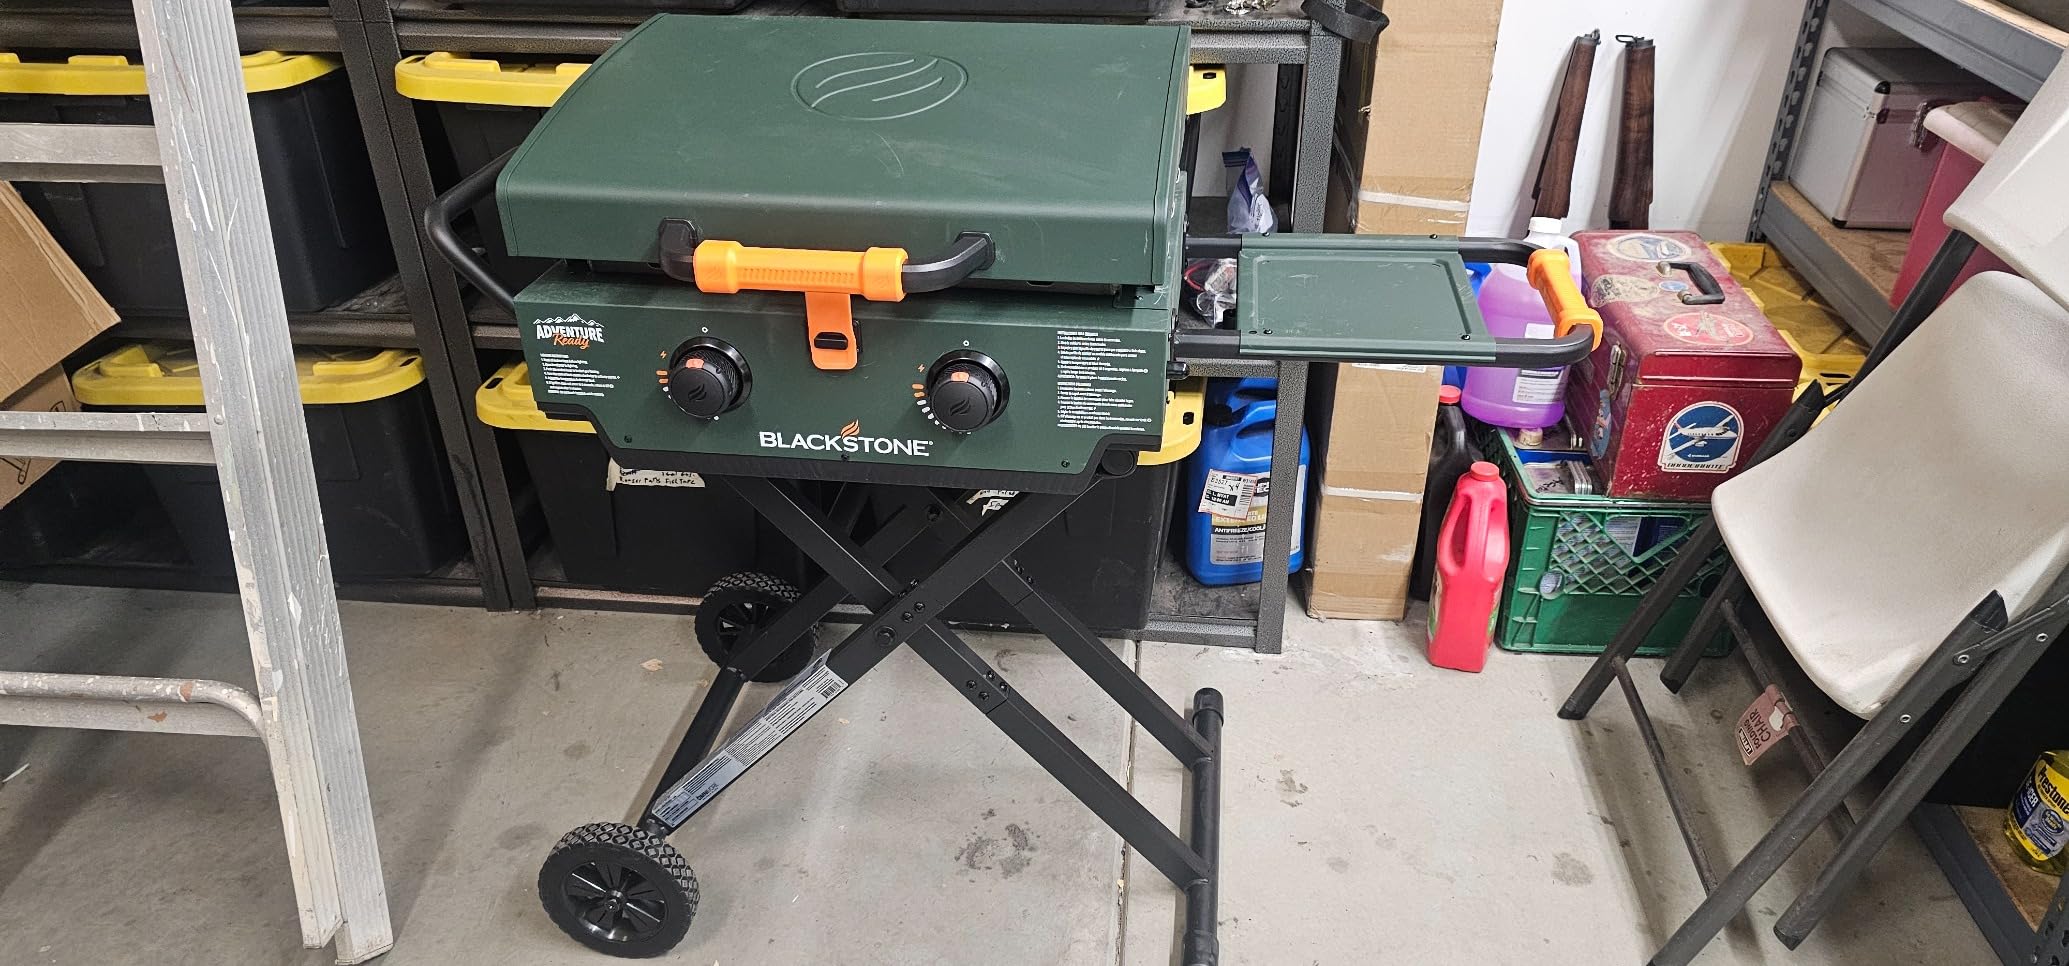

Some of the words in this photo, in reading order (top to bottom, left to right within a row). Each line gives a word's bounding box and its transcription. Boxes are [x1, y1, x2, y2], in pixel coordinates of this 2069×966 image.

[536, 325, 605, 343] ADVENTURE
[553, 333, 590, 349] Ready
[759, 431, 930, 456] BLACKSTONE
[1744, 719, 1761, 749] FOLDING
[1750, 708, 1771, 742] CHAIR
